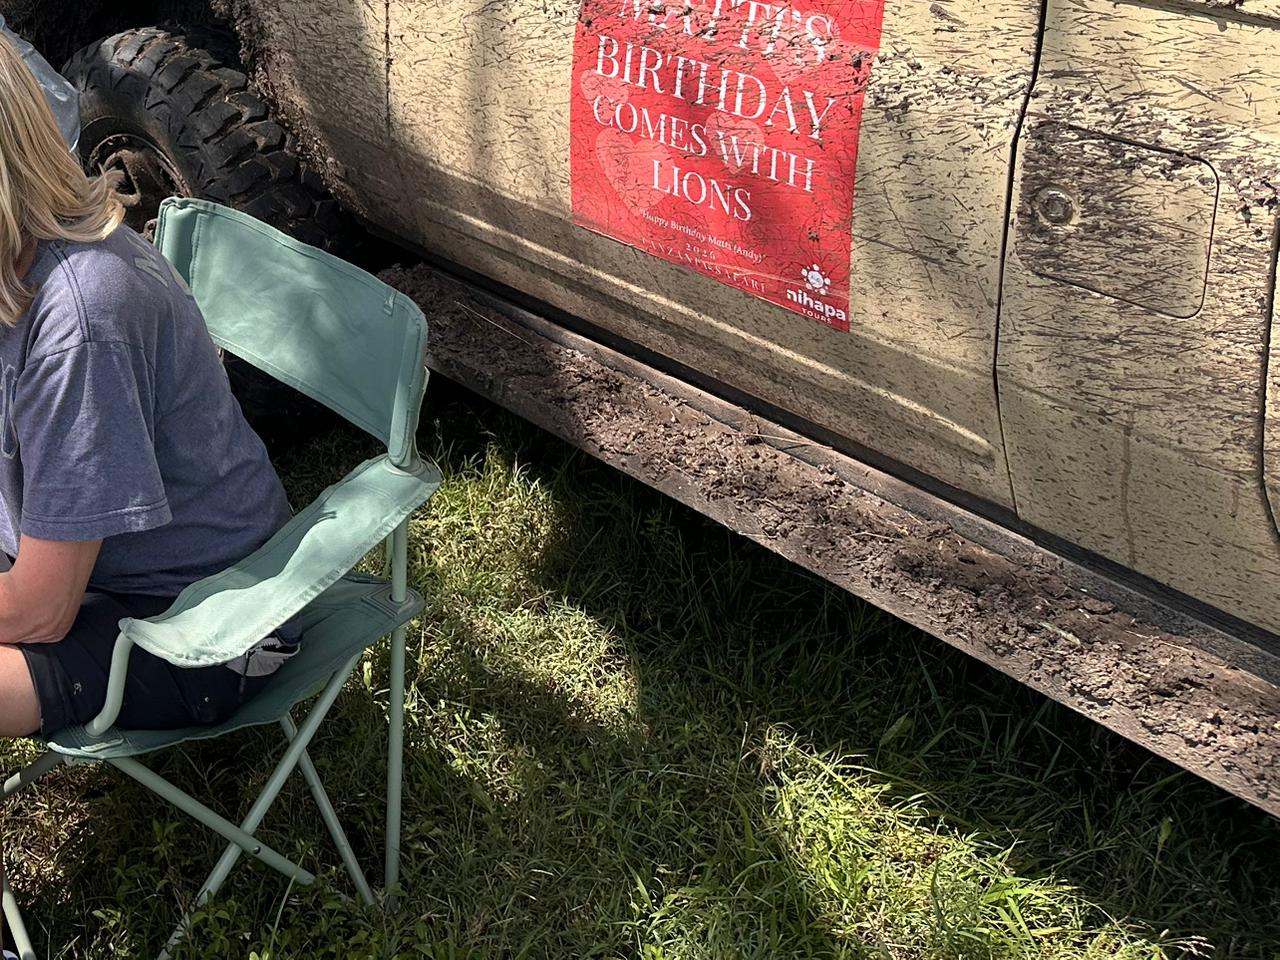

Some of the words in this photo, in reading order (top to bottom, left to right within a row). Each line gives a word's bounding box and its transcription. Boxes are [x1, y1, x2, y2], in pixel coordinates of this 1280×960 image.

[594, 33, 837, 141] BIRTHDAY
[592, 94, 708, 157] COMES
[716, 131, 816, 193] WITH
[651, 159, 753, 222] LIONS
[786, 289, 846, 321] nihapa
[801, 307, 833, 324] TOURS
